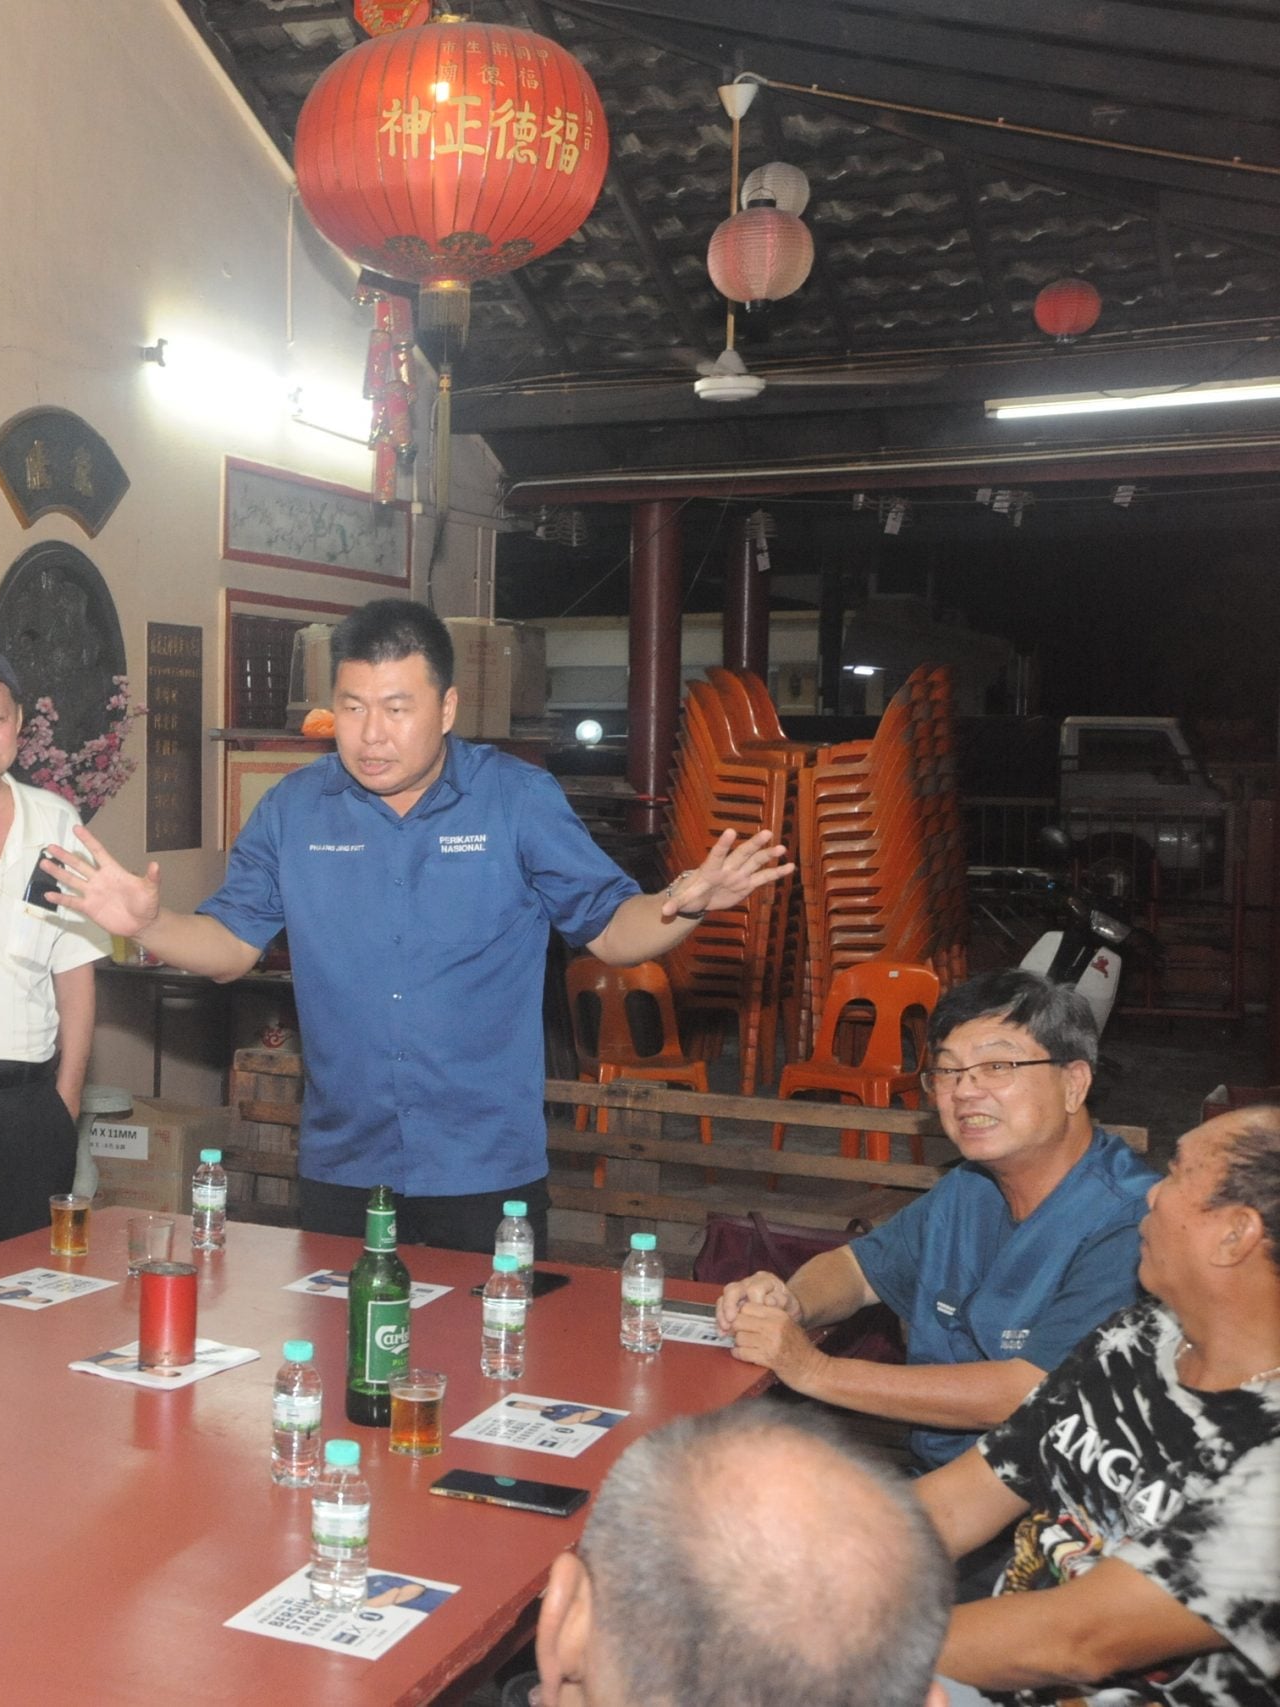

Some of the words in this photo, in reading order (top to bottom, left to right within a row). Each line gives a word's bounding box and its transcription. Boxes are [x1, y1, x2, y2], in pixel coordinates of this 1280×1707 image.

[379, 95, 580, 175] 福德正神
[439, 834, 487, 845] PERIKATAN
[440, 843, 486, 854] NASIONAL
[99, 1128, 107, 1138] X
[109, 1129, 138, 1140] 11MM
[375, 1324, 409, 1354] Carls
